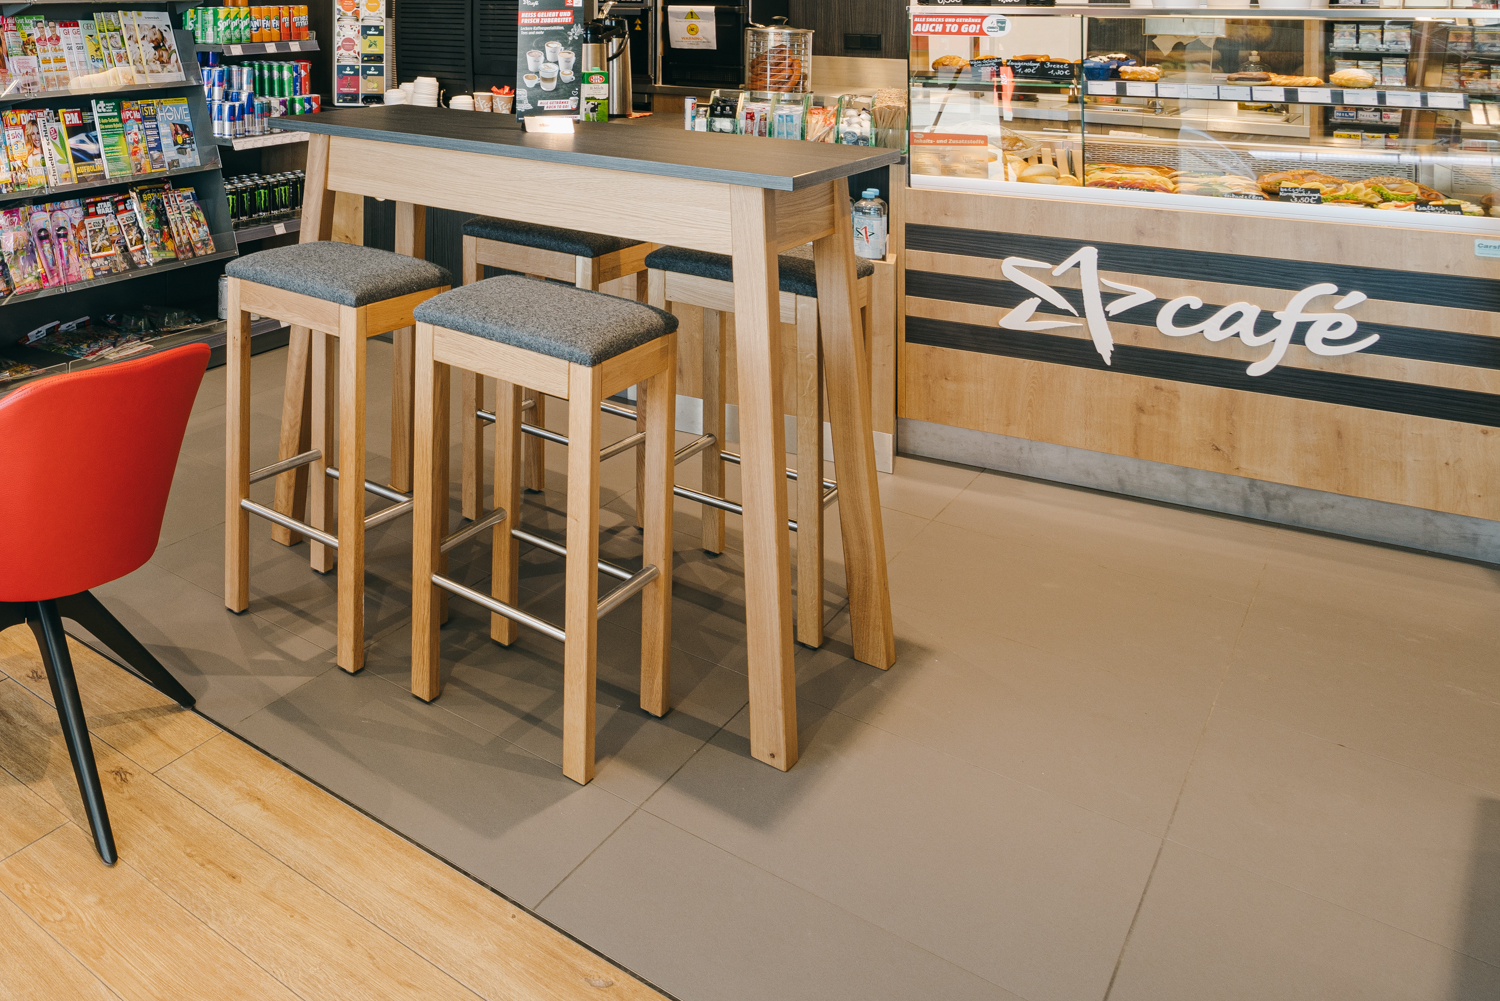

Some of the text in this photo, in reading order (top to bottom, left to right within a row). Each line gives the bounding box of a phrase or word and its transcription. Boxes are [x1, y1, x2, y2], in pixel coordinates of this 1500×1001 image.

[914, 23, 981, 33] AUCH TO GO!
[64, 113, 82, 125] P.M.
[1156, 283, 1380, 376] café
